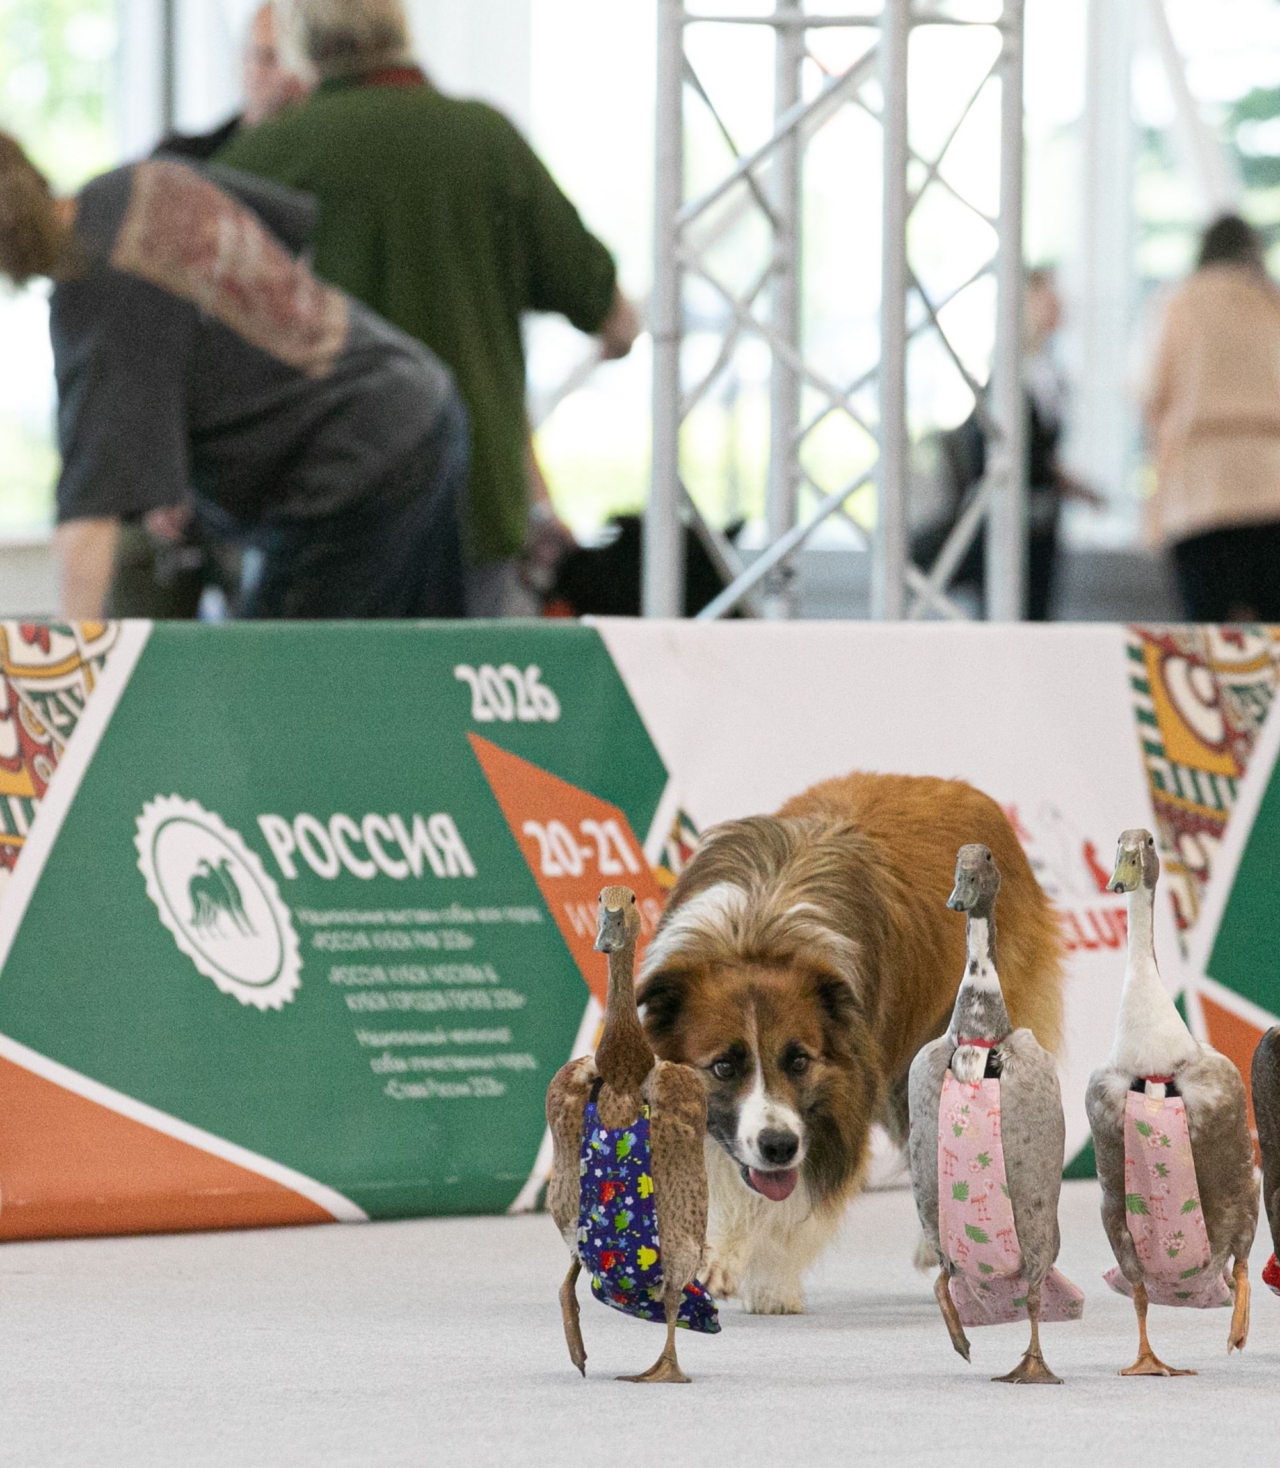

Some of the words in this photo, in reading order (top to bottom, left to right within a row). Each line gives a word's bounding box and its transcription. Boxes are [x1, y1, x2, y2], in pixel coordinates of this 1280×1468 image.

[454, 664, 561, 722] 2026
[256, 812, 477, 880] РОССИЯ
[522, 818, 641, 878] 20-21
